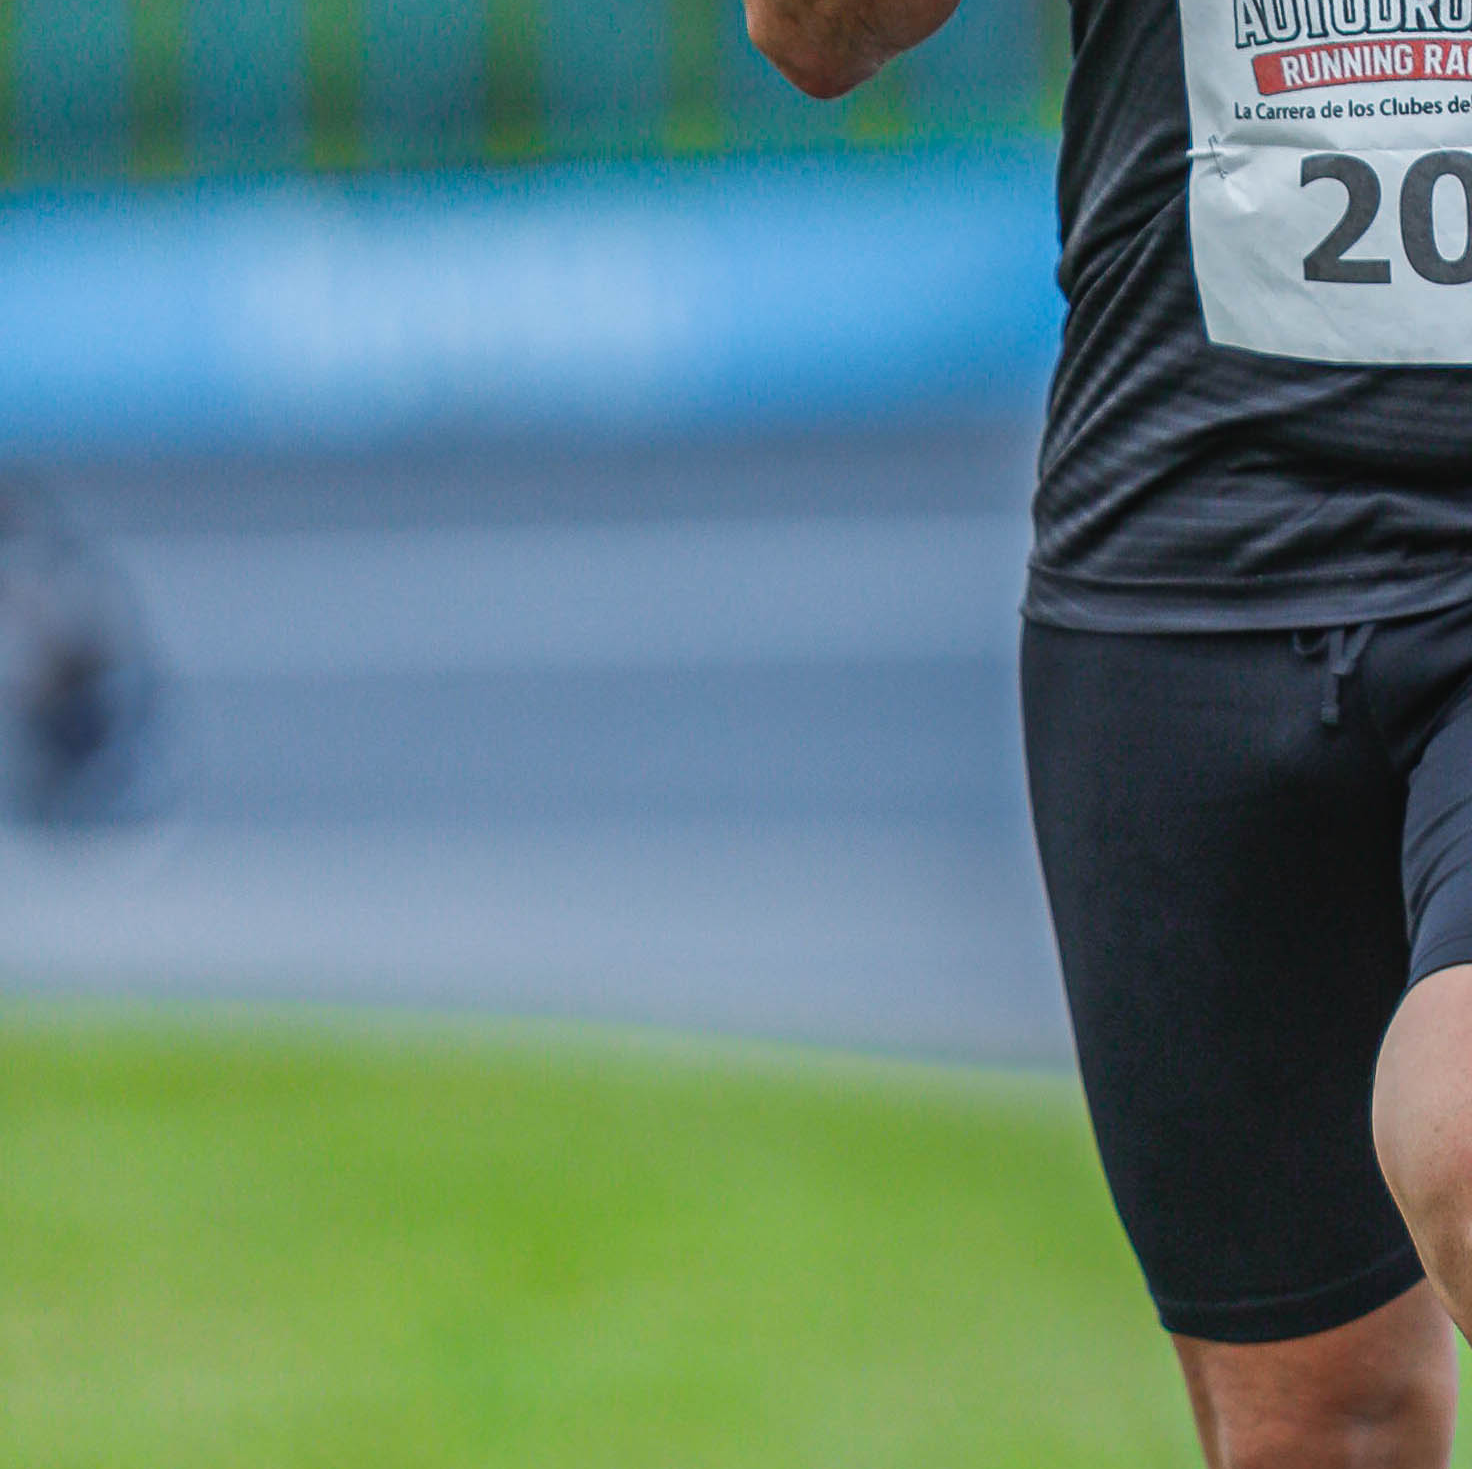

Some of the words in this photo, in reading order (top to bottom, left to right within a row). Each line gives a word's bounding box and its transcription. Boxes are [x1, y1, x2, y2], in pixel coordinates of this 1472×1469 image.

[1280, 43, 1414, 87] RUNNING
[1234, 101, 1251, 120] La
[1256, 102, 1316, 120] Carrera
[1320, 99, 1344, 118] de
[1348, 99, 1375, 118] los
[1380, 96, 1443, 116] Clubes
